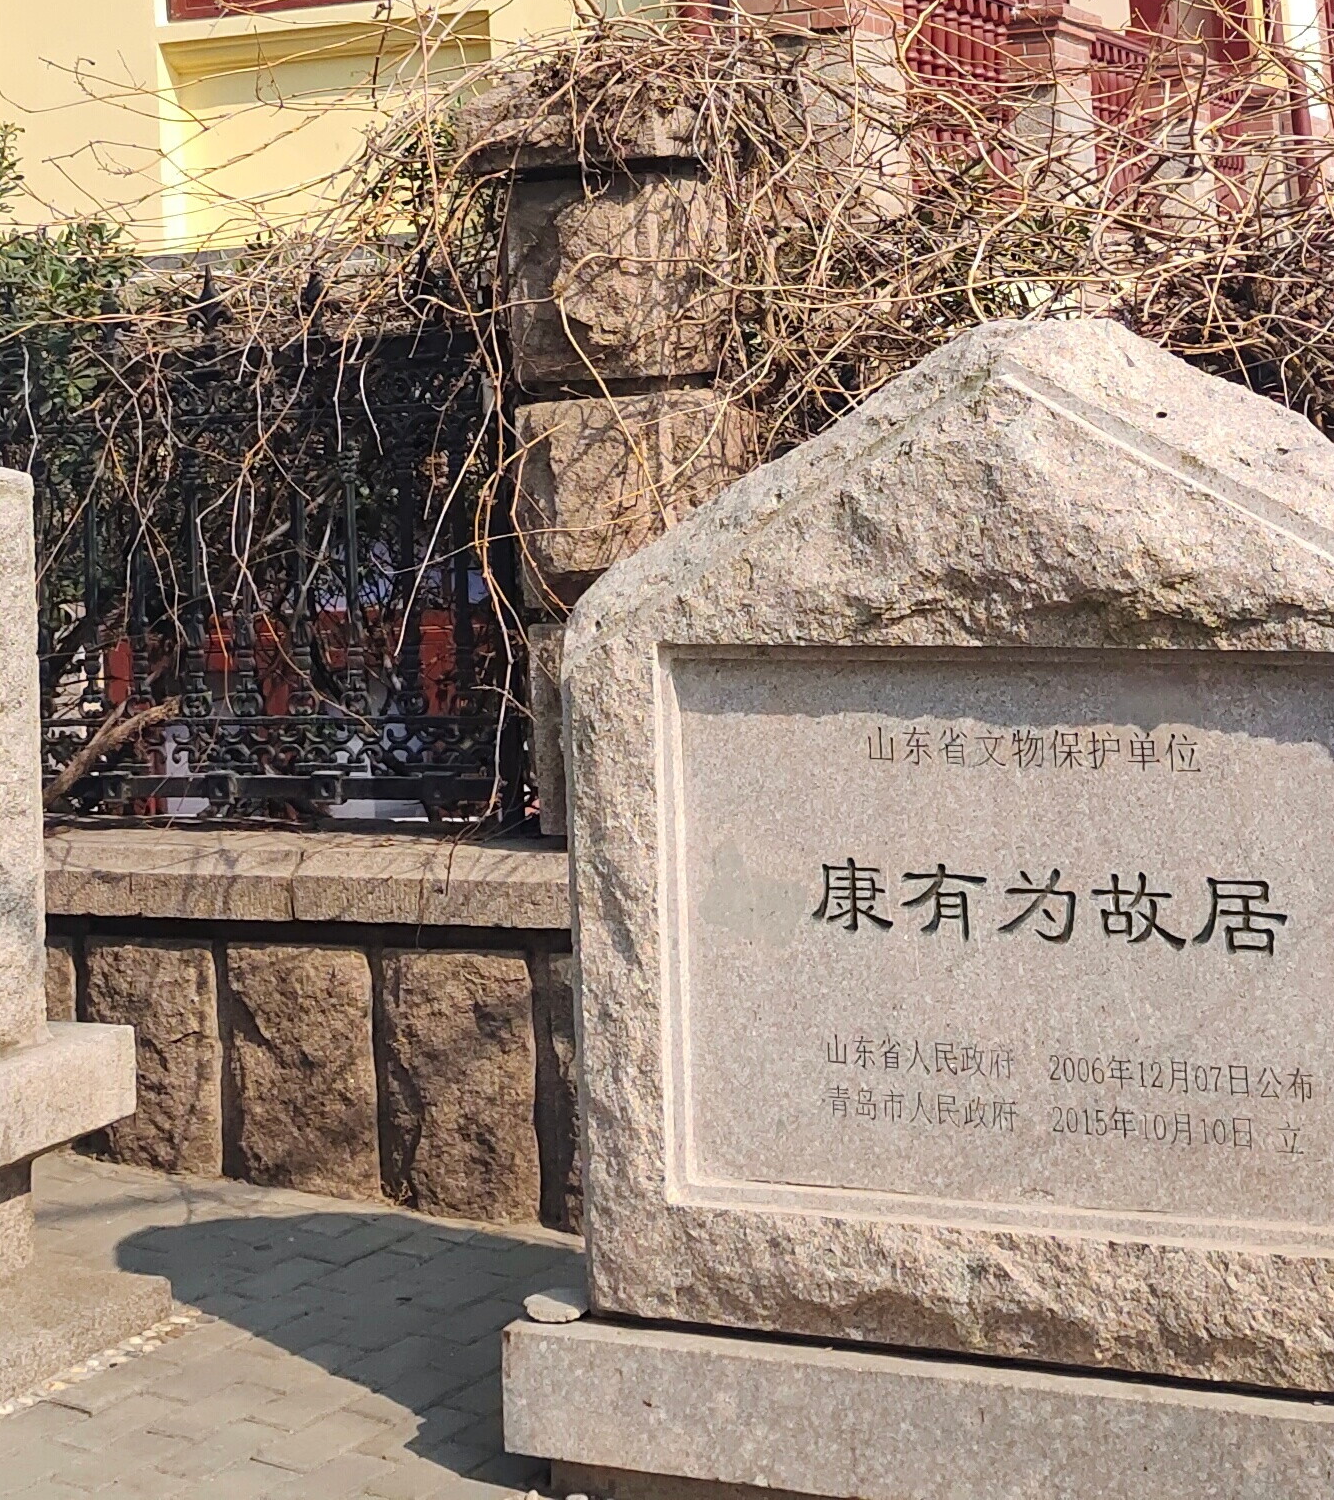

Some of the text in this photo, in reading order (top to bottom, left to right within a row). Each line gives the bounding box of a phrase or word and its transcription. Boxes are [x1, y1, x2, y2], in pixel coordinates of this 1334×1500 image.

[866, 726, 1201, 773] 山东省文物保护单位
[811, 857, 1289, 956] 康有为故居
[826, 1033, 1315, 1104] 山东省人民政府 2006年12月07日公布
[826, 1084, 1306, 1157] 青岛市人民政府 2015年10月10日 立
